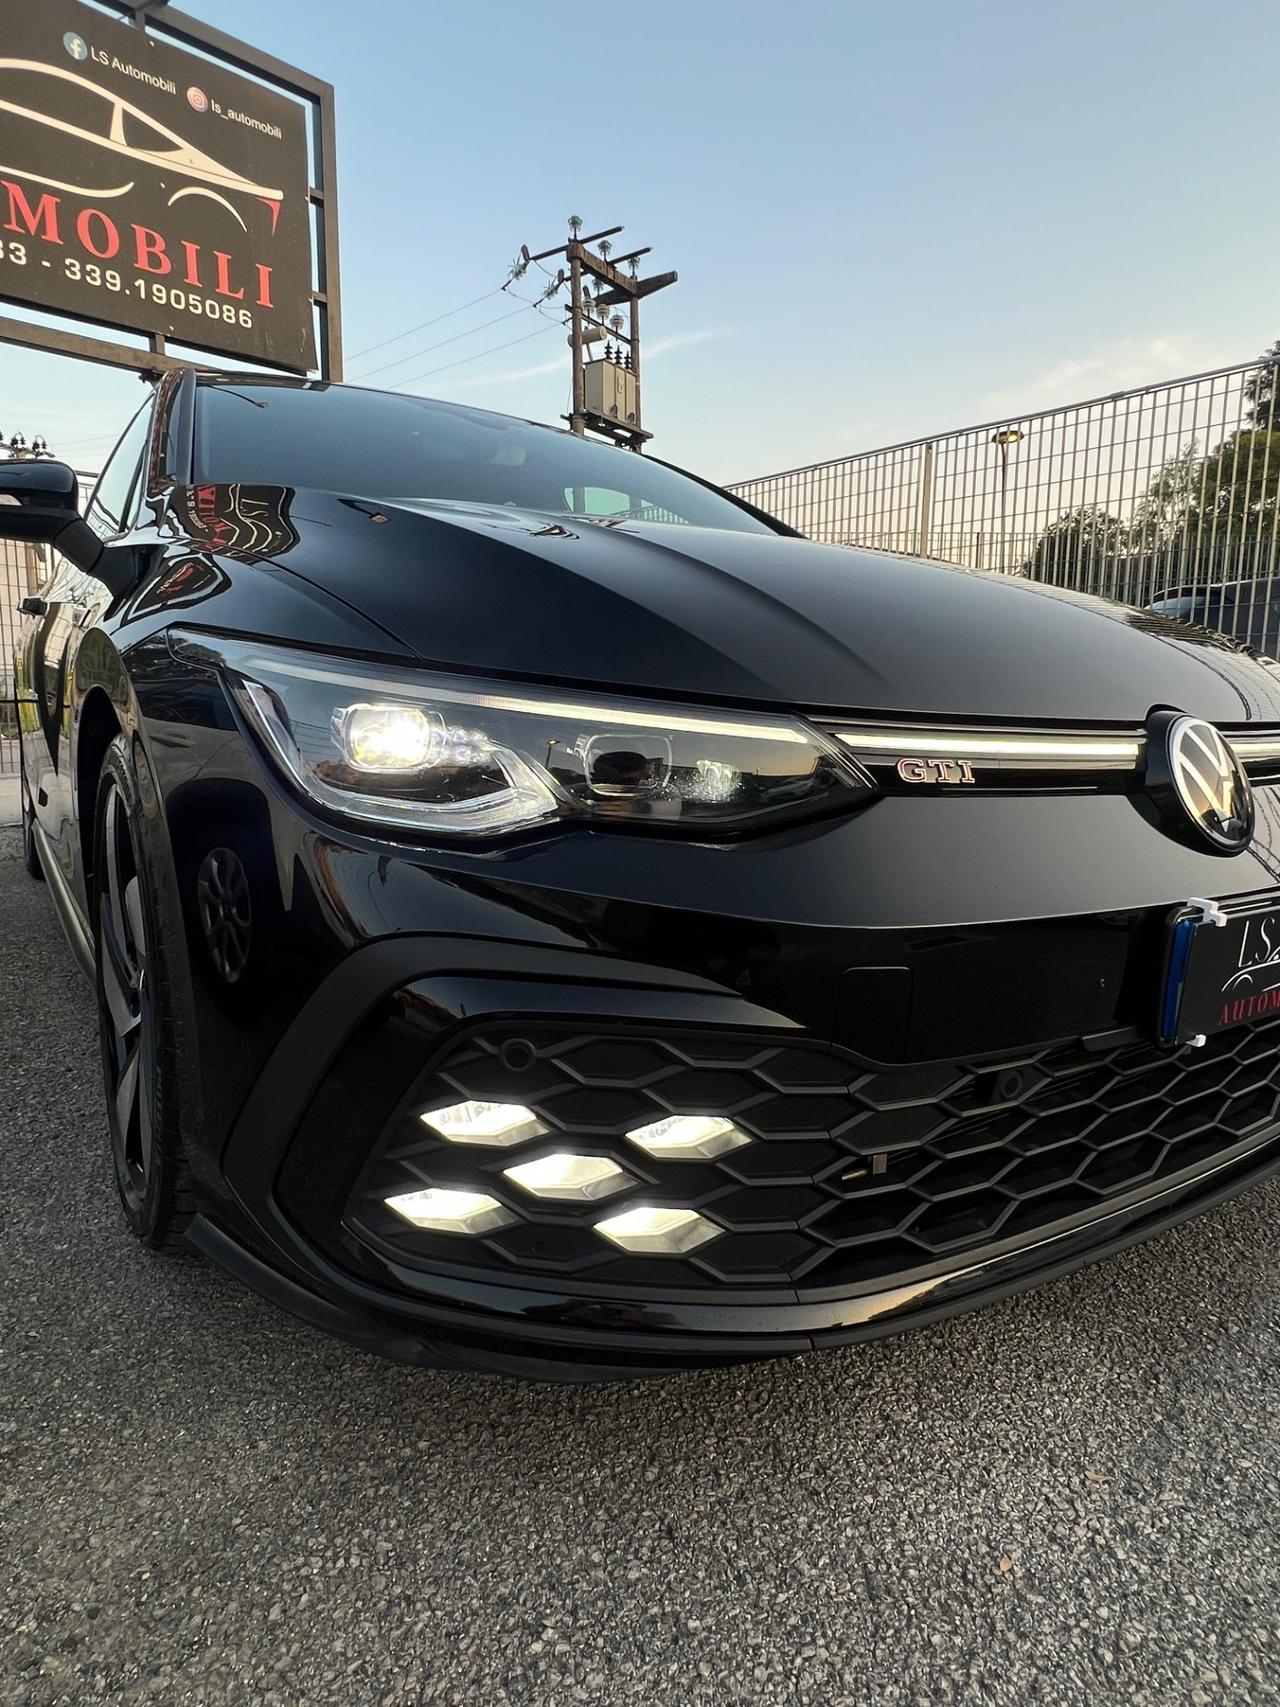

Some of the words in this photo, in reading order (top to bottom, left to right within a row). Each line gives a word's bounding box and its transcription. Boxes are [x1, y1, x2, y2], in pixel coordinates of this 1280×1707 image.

[90, 45, 109, 66] LS
[111, 57, 177, 96] Automobili
[211, 98, 283, 140] ls_automobili
[0, 179, 274, 309] MOBILI
[0, 240, 27, 265] 3
[64, 257, 253, 329] 339.1905086
[897, 758, 976, 784] GTI
[1238, 916, 1276, 968] LS
